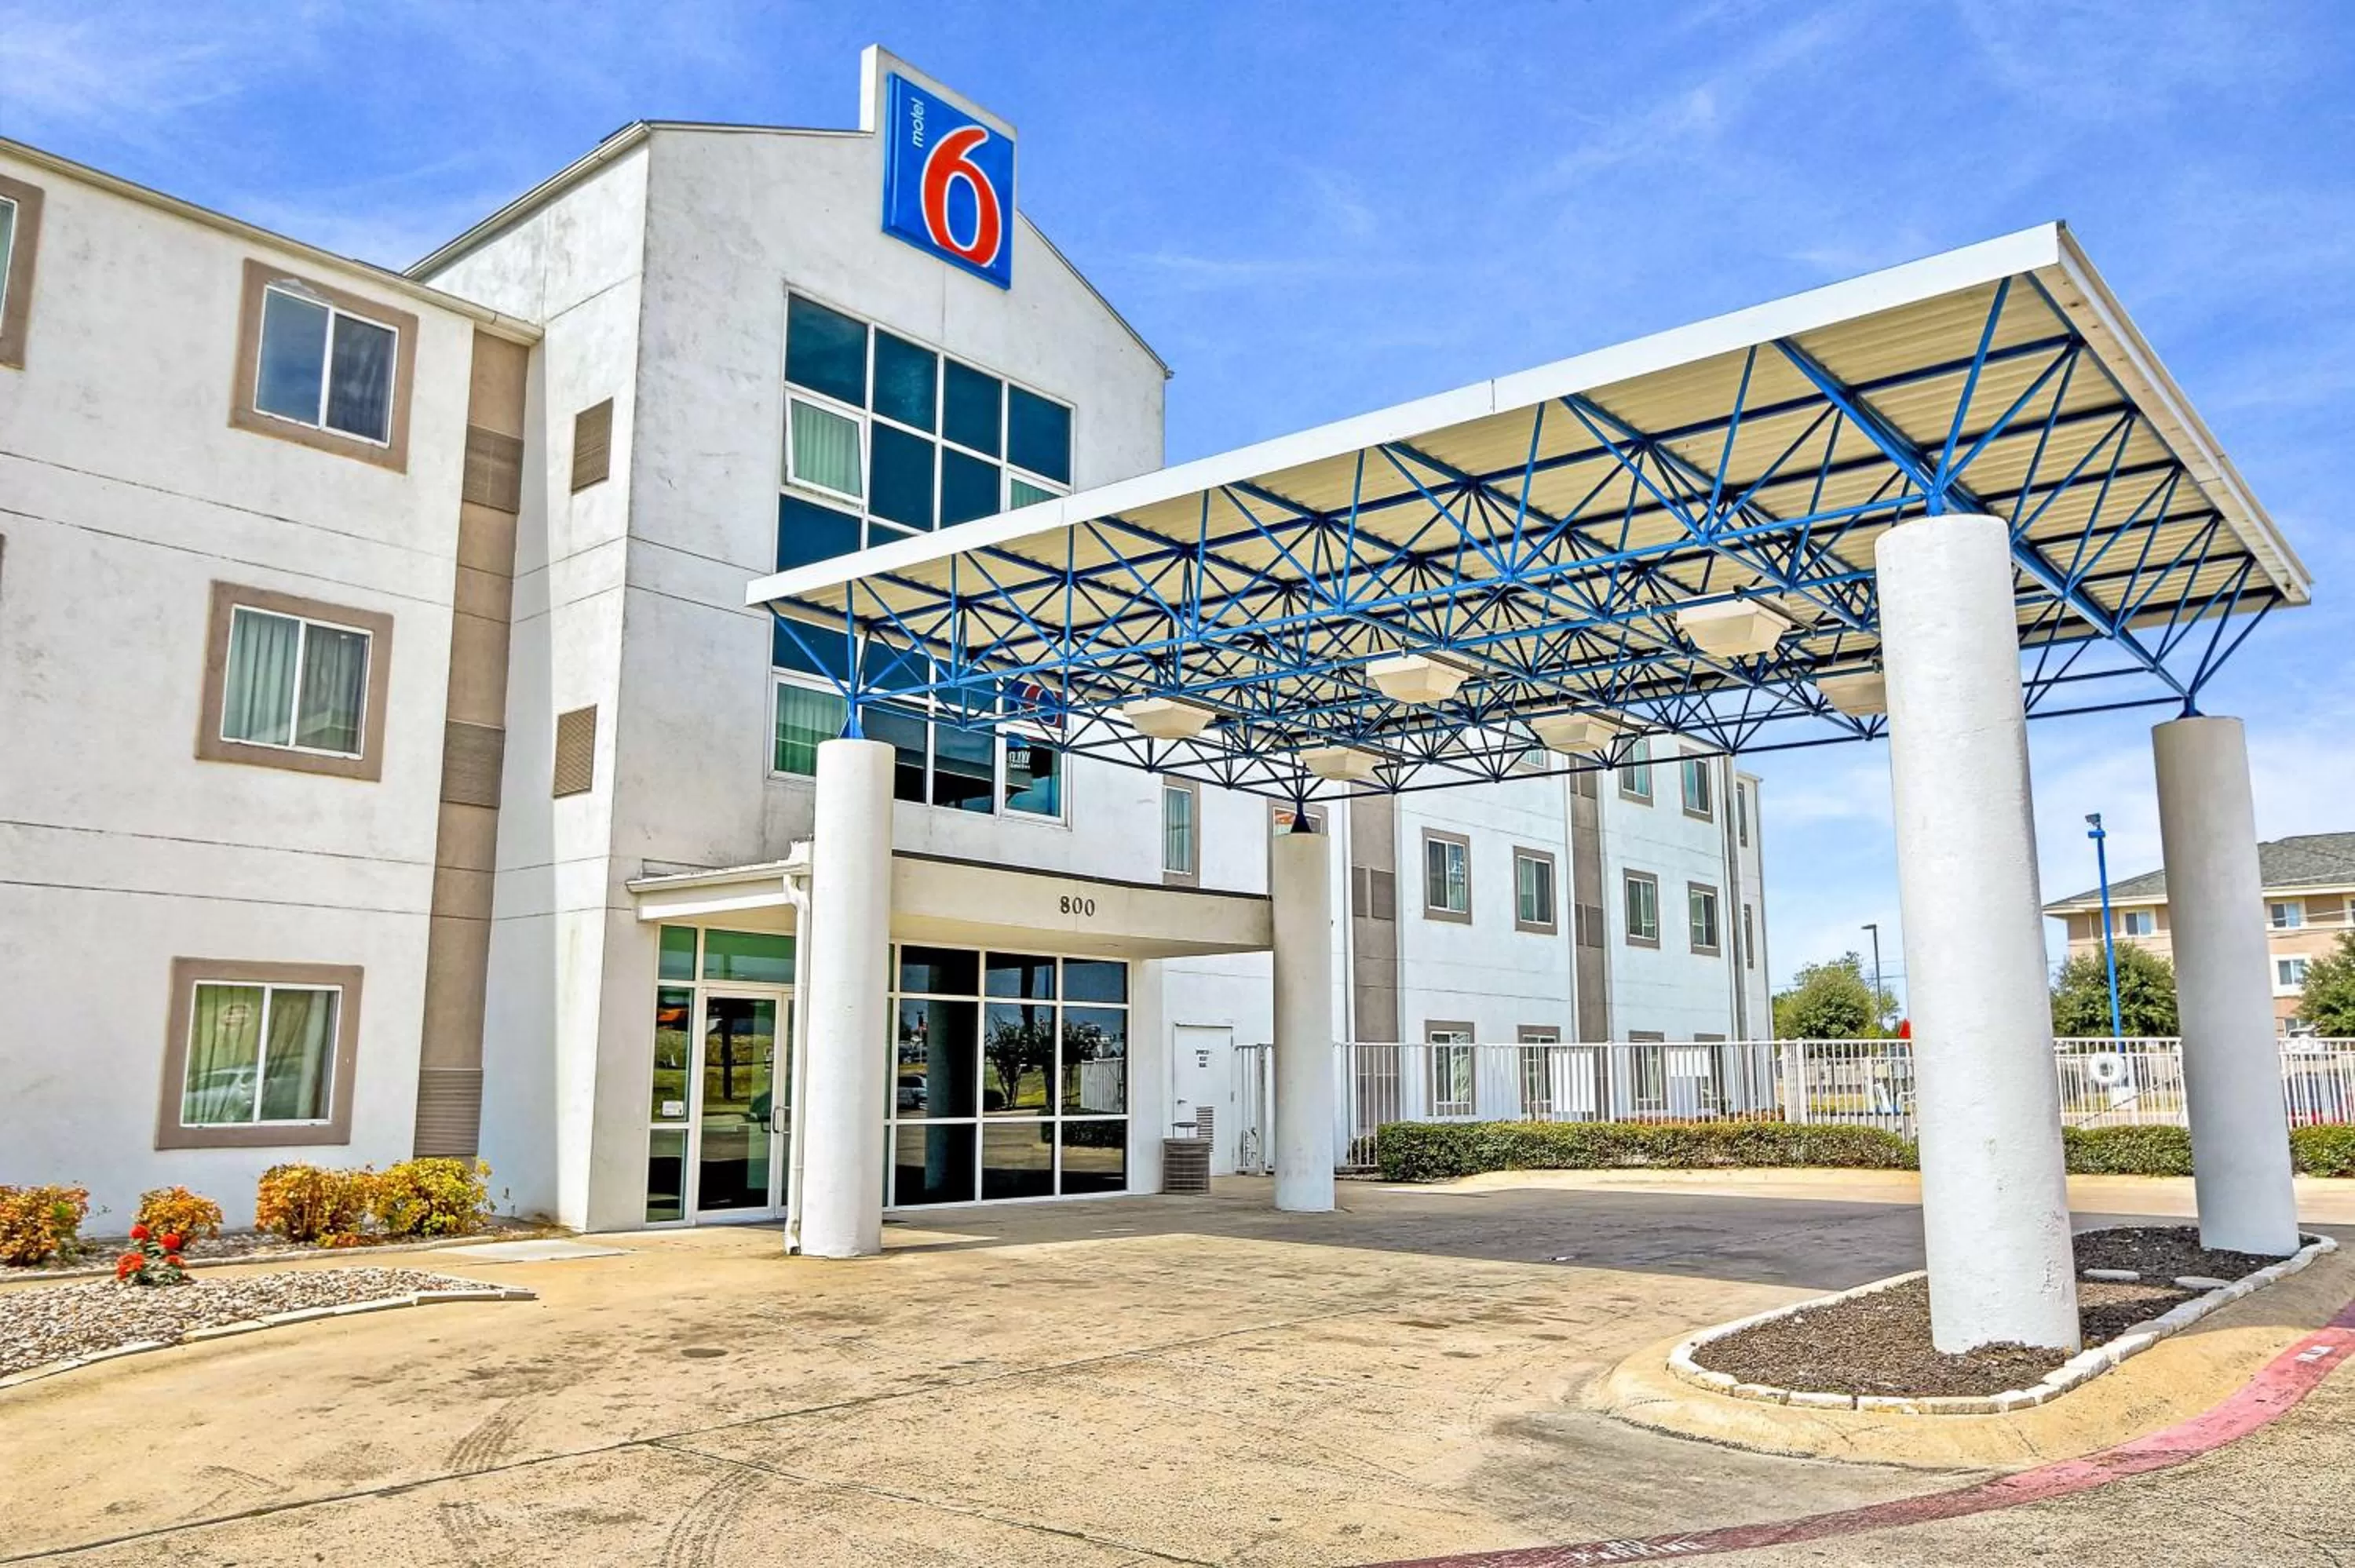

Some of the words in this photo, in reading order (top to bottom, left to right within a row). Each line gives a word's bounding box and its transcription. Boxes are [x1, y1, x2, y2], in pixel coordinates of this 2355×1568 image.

[911, 97, 924, 148] motel
[921, 125, 1001, 267] 6
[1061, 895, 1095, 917] 800
